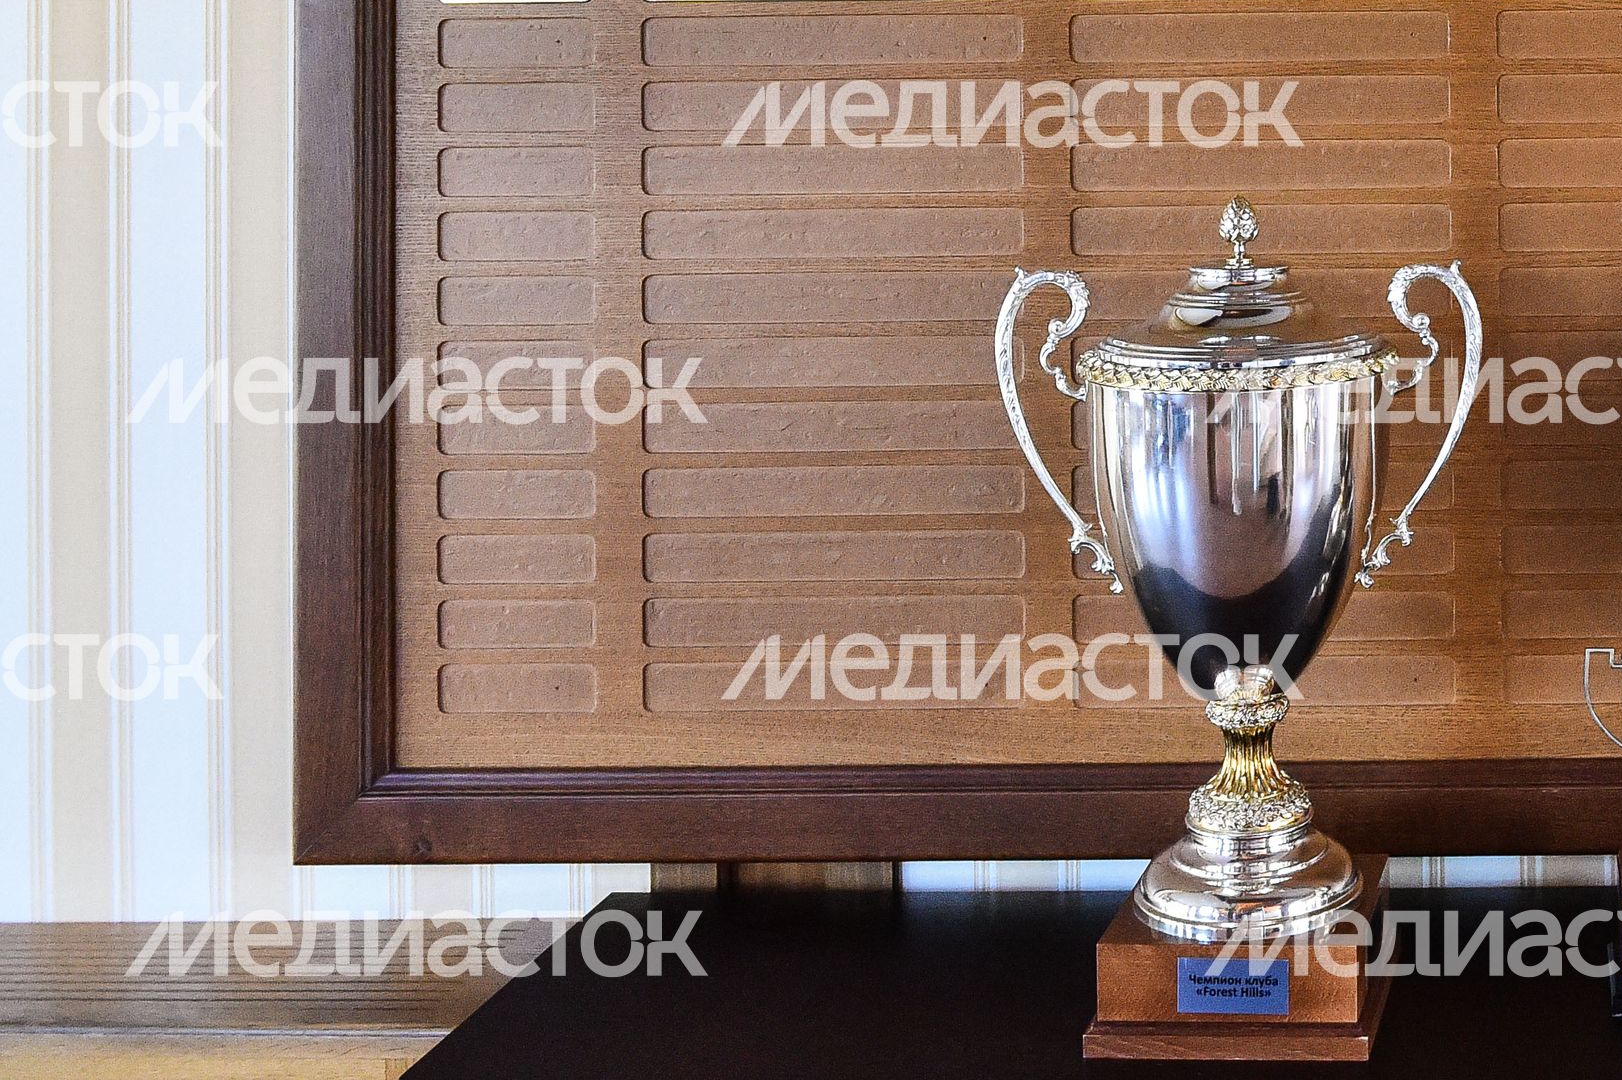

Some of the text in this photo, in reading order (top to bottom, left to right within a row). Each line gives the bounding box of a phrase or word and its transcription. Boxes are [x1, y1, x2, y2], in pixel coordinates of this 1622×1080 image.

[1188, 974, 1279, 987] Чемпион клуба
[1196, 987, 1272, 998] «Forest Hills»
